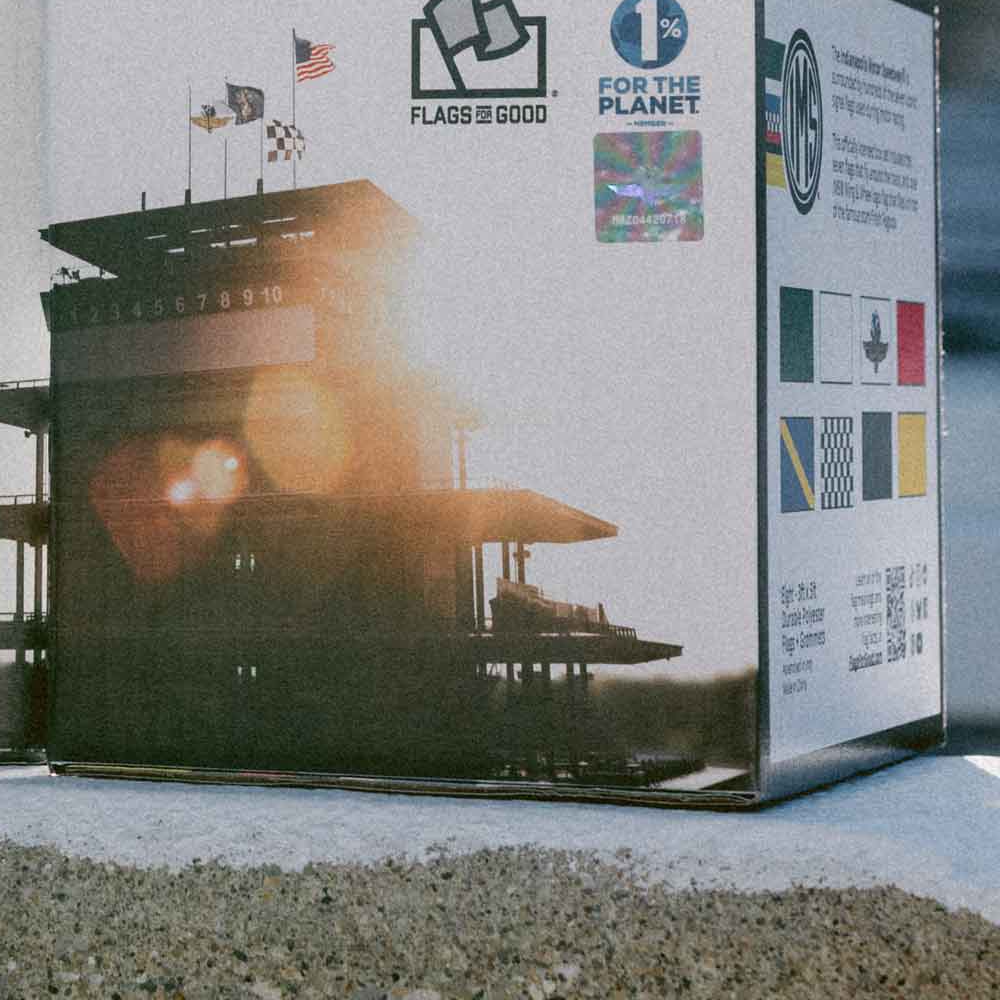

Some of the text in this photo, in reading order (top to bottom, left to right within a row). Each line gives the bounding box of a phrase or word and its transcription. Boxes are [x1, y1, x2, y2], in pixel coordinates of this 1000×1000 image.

[599, 75, 700, 94] FOR THE
[411, 105, 547, 125] FLAGS FOR GOOD
[175, 298, 185, 313] 6
[198, 294, 208, 311] 7
[219, 291, 231, 309] 8
[242, 288, 253, 306] 9
[262, 285, 282, 304] 10
